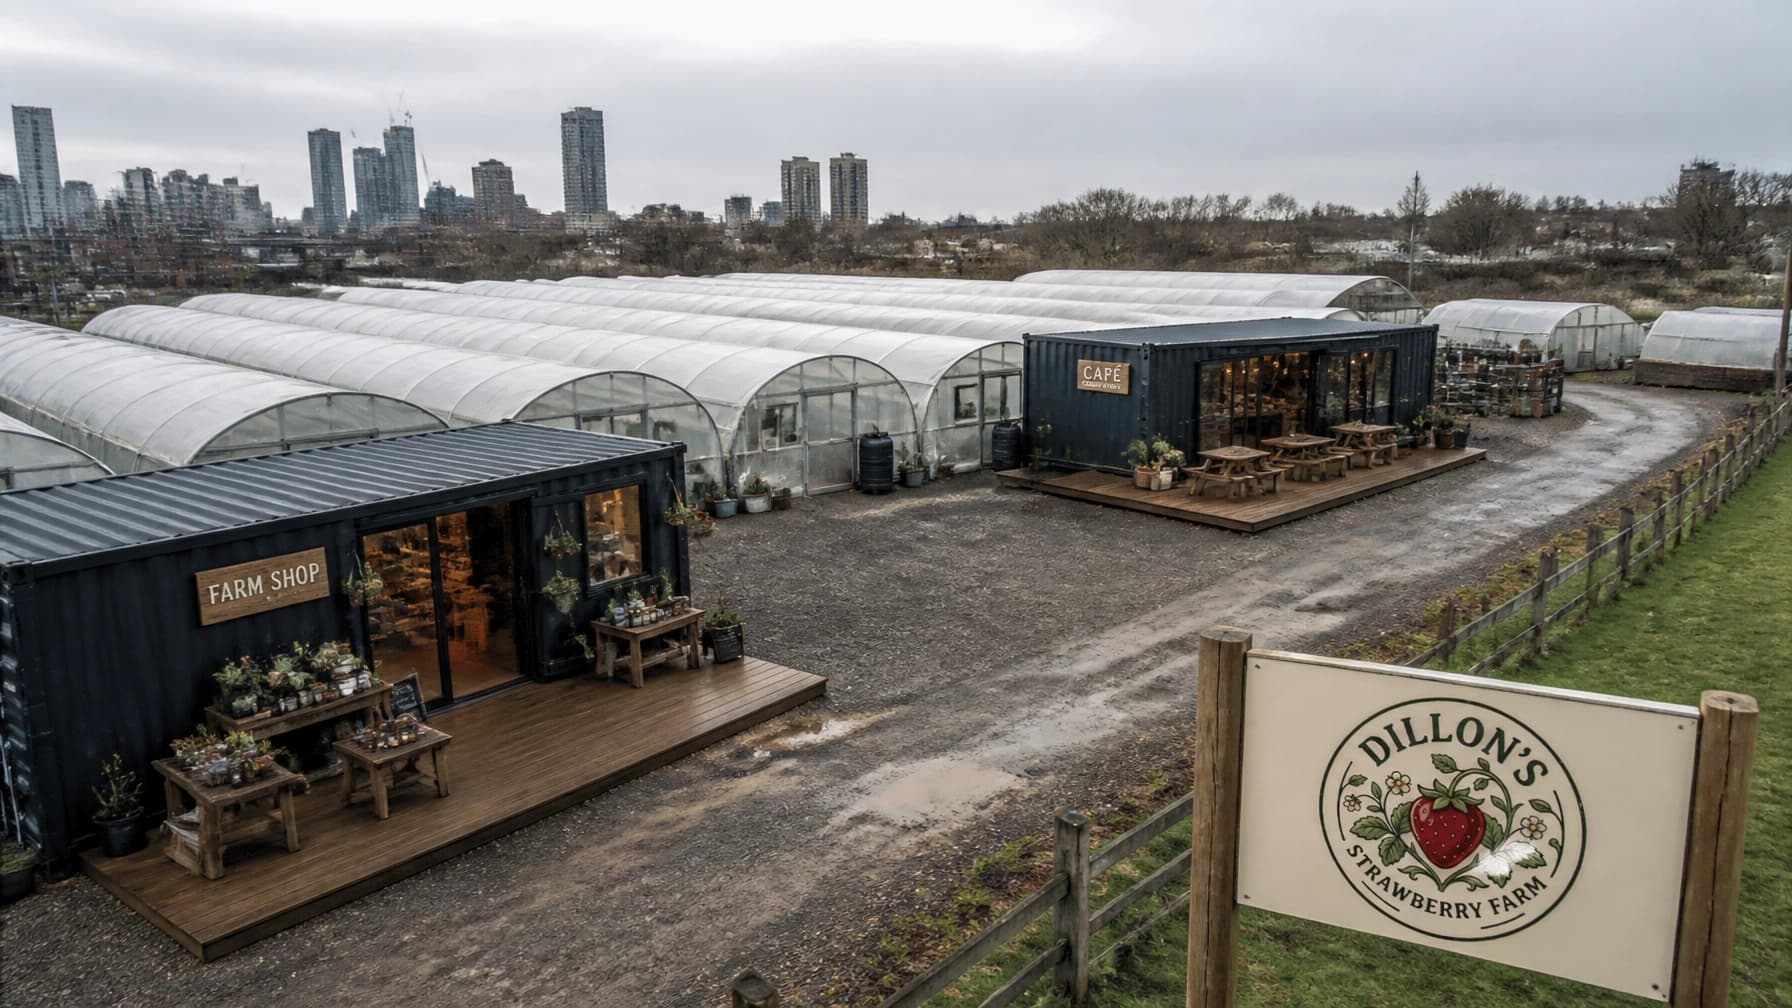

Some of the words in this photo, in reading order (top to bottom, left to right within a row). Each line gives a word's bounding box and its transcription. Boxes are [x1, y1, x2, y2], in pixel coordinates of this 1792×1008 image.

[208, 575, 264, 605] FARM
[271, 562, 320, 591] SHOP
[1358, 713, 1549, 787] DILLON'S
[1346, 844, 1483, 919] STRAWBERRY
[1488, 876, 1548, 915] FARM
